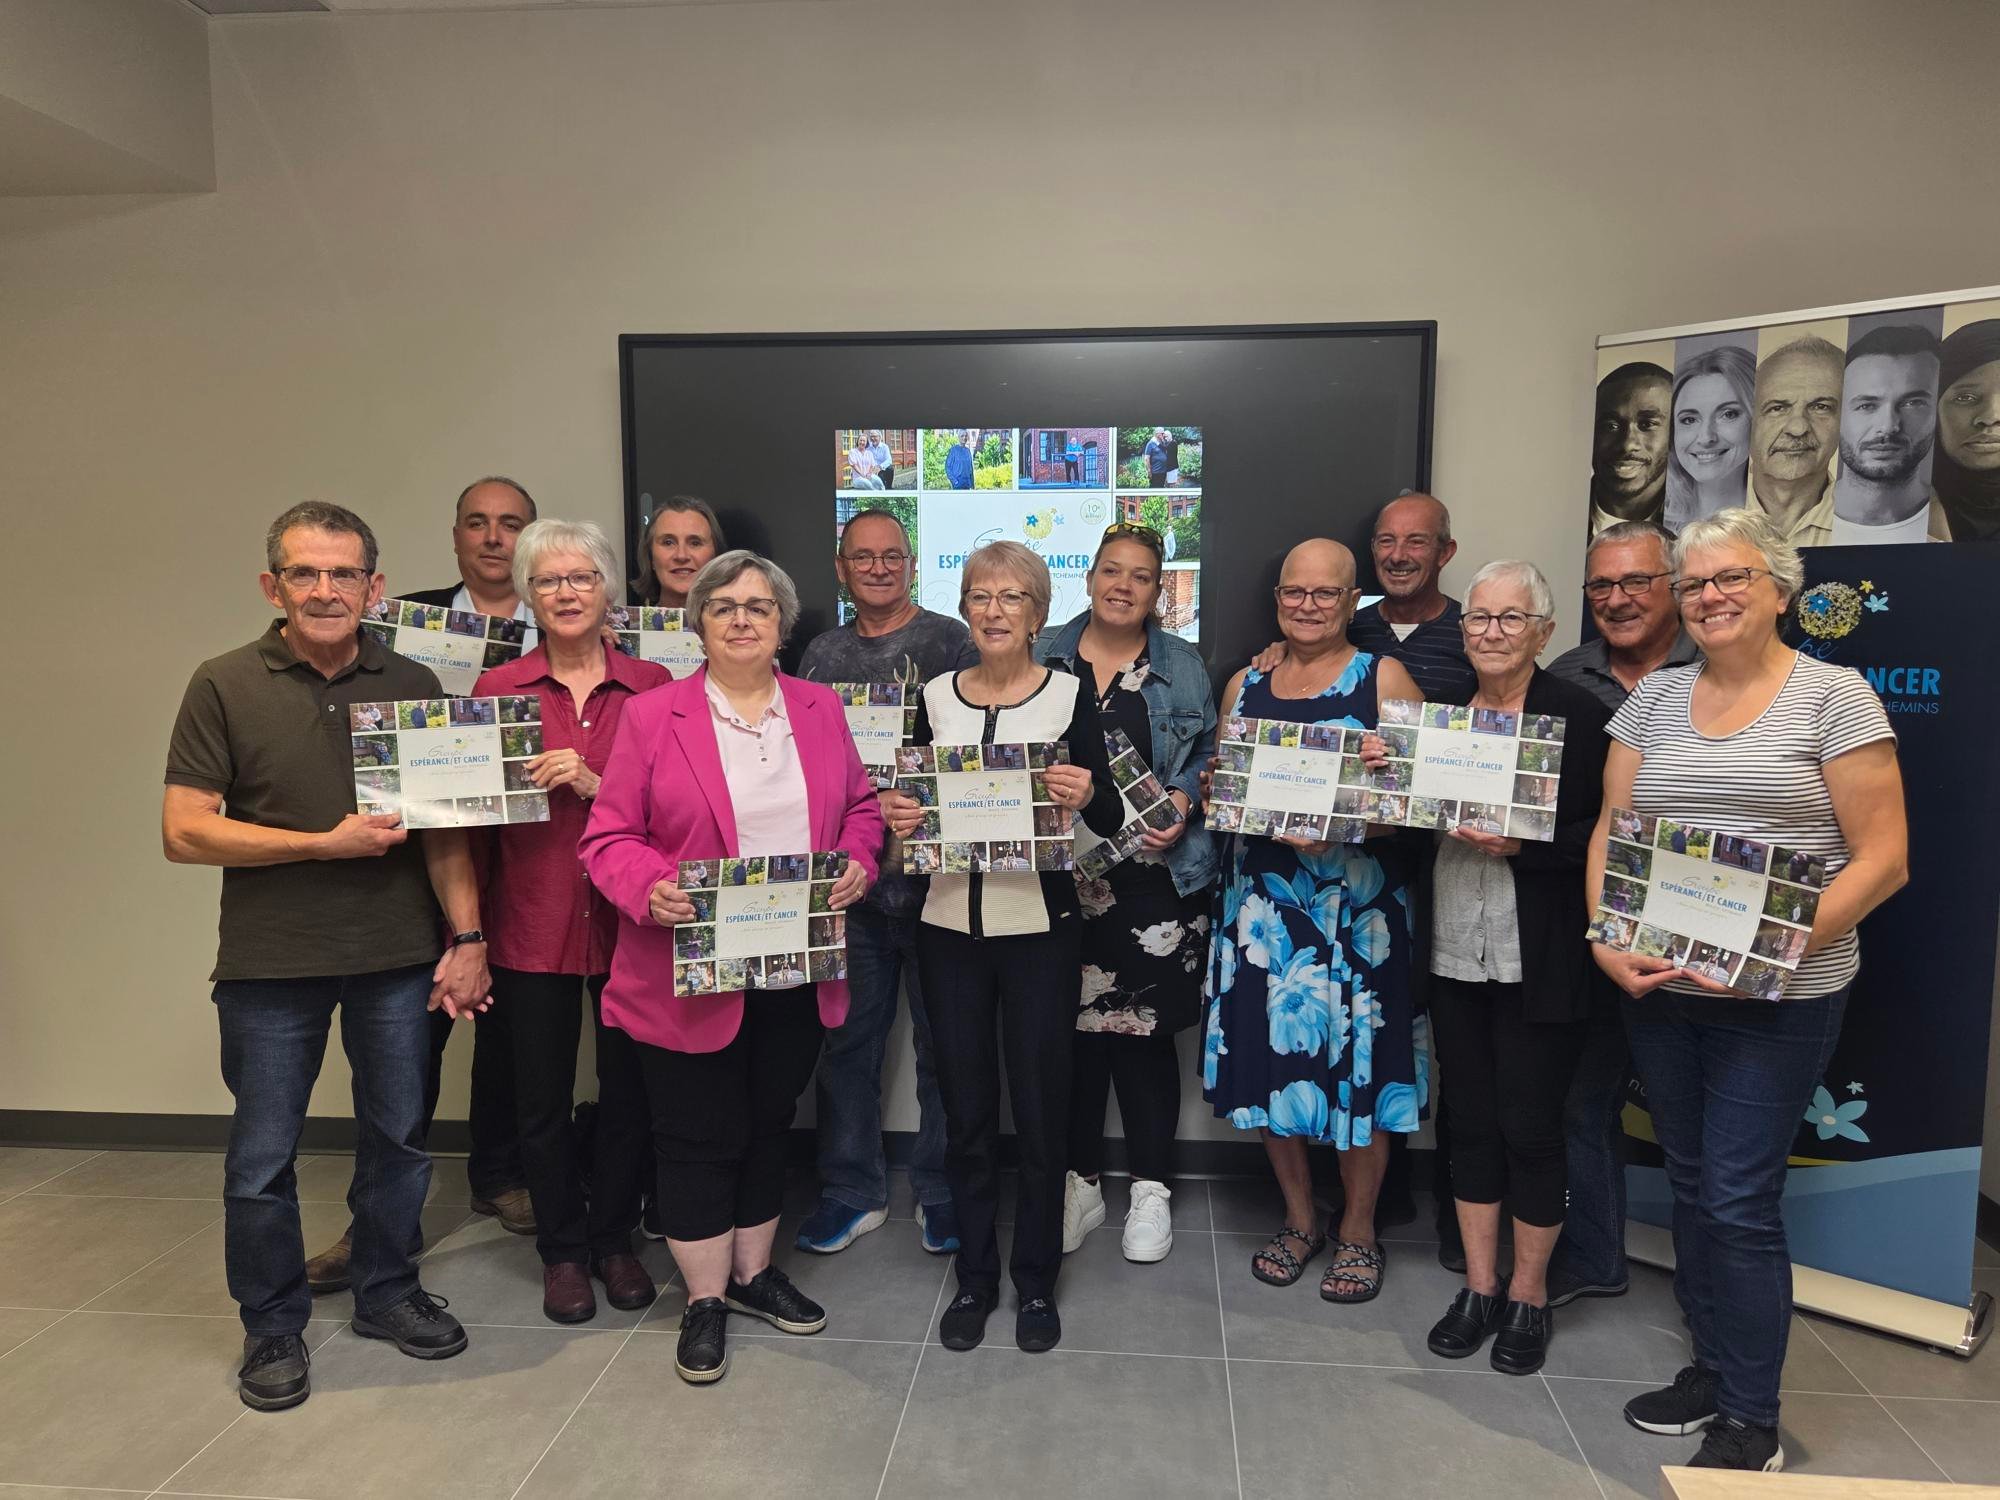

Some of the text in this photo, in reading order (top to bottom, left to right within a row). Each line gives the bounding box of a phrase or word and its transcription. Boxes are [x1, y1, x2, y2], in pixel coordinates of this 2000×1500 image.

[448, 659, 472, 668] CANCER
[1864, 667, 1941, 695] NCER
[1882, 702, 1940, 714] HEMINS
[410, 757, 449, 767] ESPÉRANCE
[454, 757, 461, 765] ET
[463, 754, 490, 764] CANCER
[1425, 755, 1463, 767] ESPÉRANCE
[1476, 761, 1503, 771] CANCER
[1295, 775, 1302, 783] ET
[1303, 776, 1327, 785] CANCER
[948, 800, 984, 809] ESPÉRANCE
[996, 799, 1021, 807] CANCER
[1660, 881, 1702, 900] ESPÉRANCE
[1706, 893, 1715, 903] ET
[1717, 897, 1748, 912] CANCER
[725, 913, 761, 924] ESPÉRANCE
[765, 912, 772, 920] ET
[774, 910, 798, 919] CANCER
